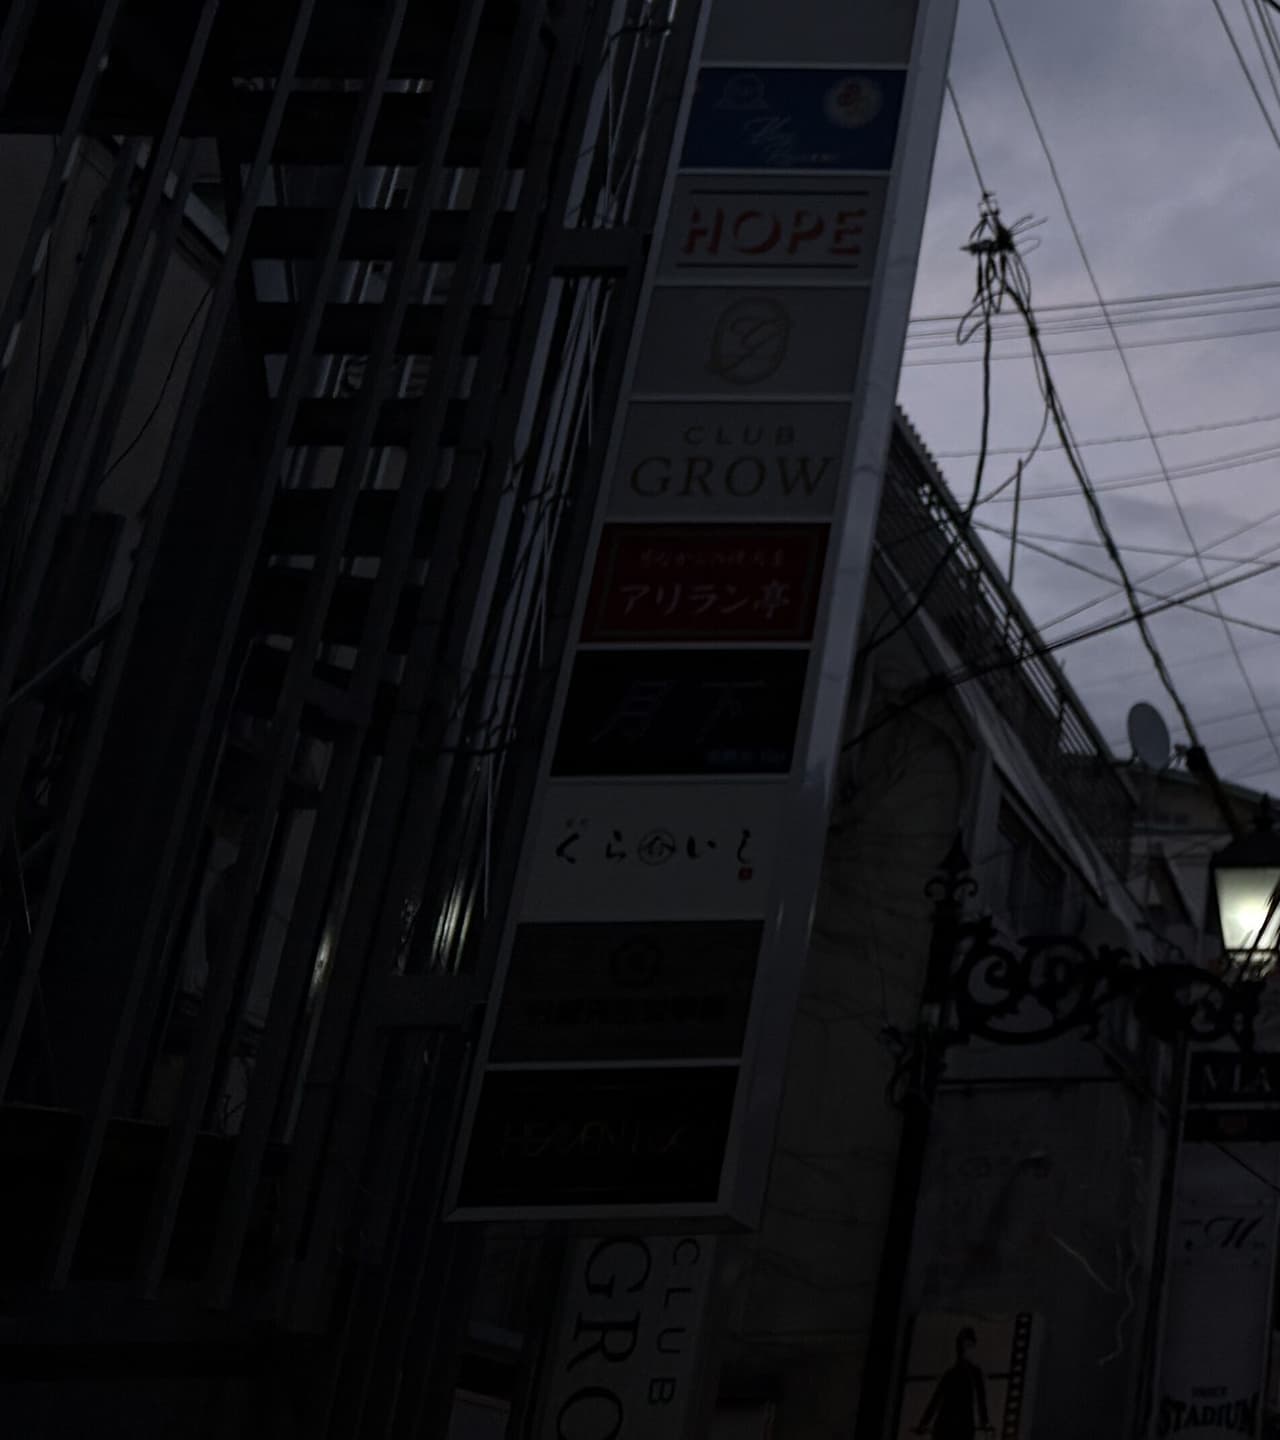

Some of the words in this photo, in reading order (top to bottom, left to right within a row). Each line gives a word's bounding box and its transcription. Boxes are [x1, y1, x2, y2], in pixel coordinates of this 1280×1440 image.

[680, 207, 868, 257] HOPE
[683, 424, 796, 447] CLUB
[629, 454, 832, 498] GROW
[619, 577, 792, 622] アリラン亭
[647, 1237, 701, 1407] CLUB
